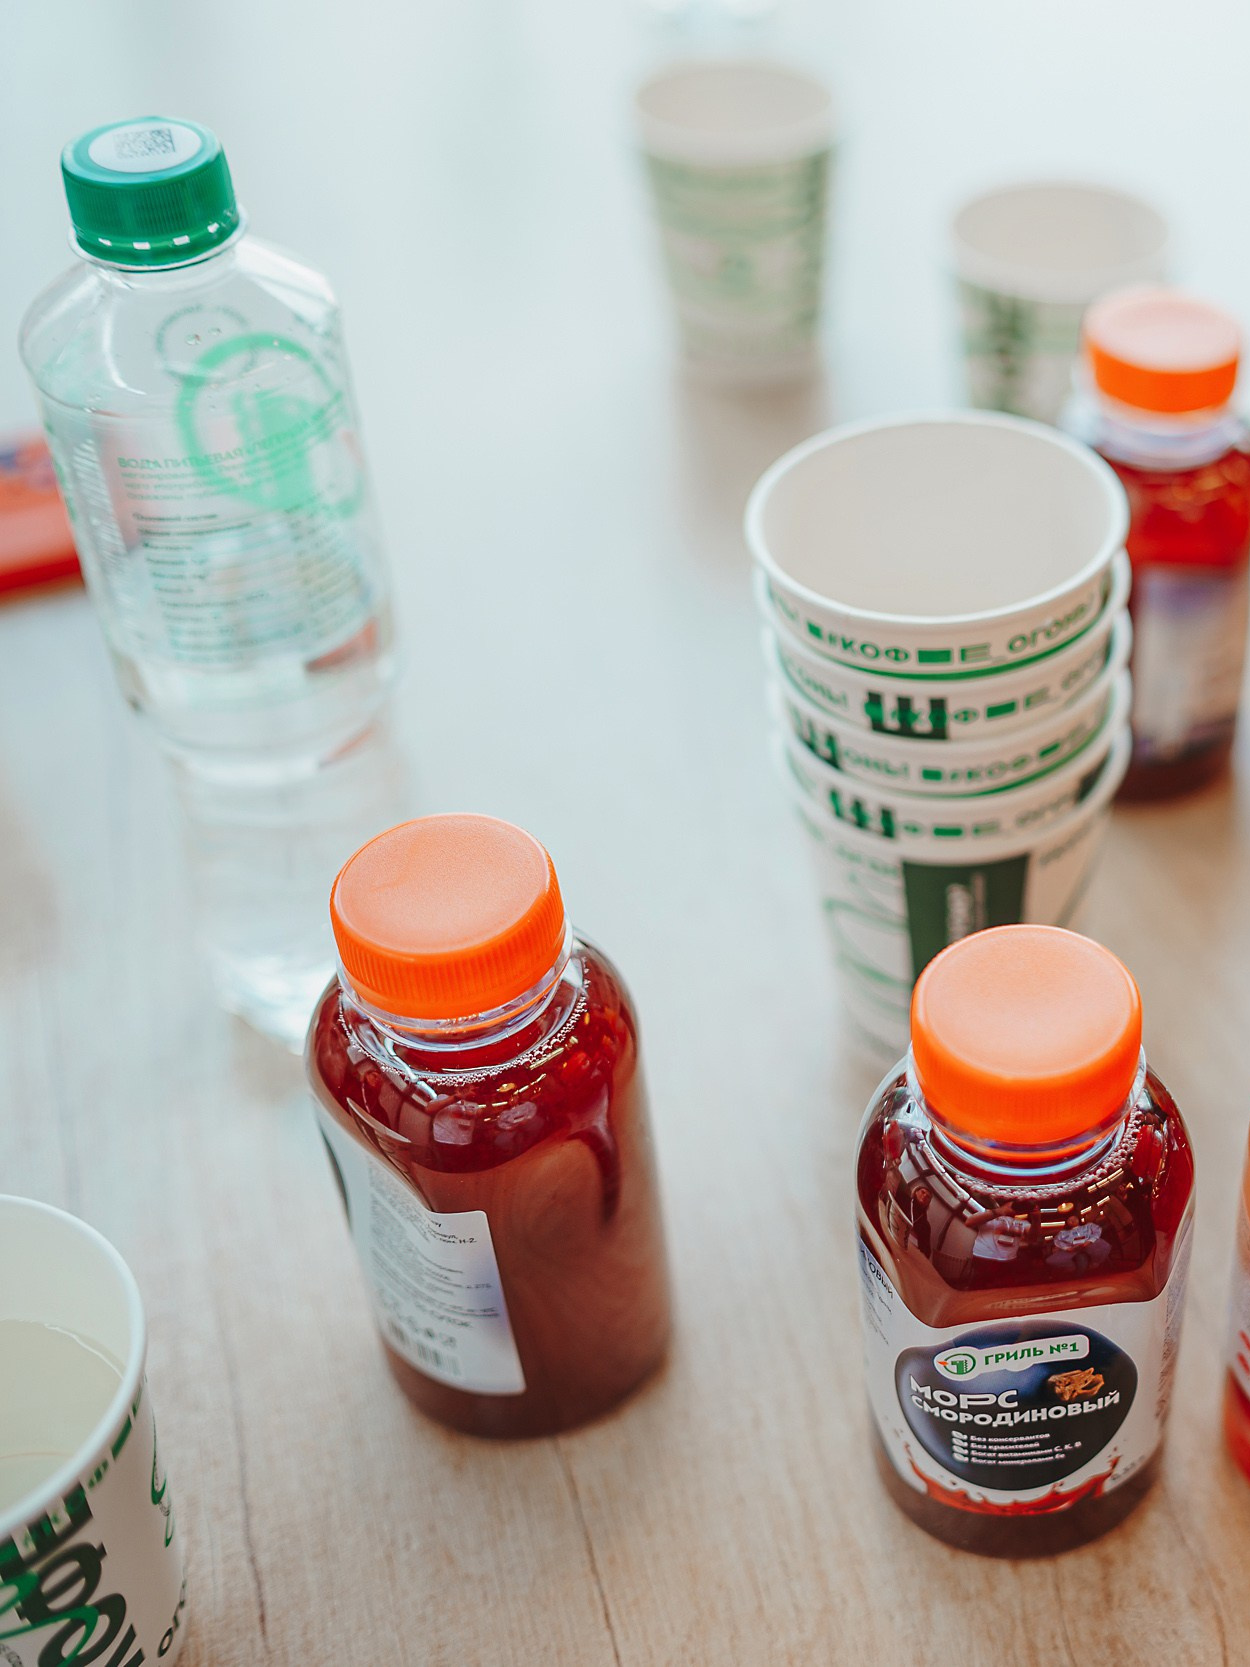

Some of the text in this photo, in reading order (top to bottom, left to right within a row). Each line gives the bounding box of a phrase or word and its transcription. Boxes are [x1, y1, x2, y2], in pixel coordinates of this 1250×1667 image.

[117, 456, 161, 470] ВОДА
[984, 1342, 1080, 1366] ГРИЛЬ №1
[909, 1374, 1019, 1410] МОРС
[910, 1389, 1121, 1428] СМОРОДИНОВЫЙ
[970, 1441, 1040, 1451] Без красителей
[988, 1432, 1051, 1443] консервантов
